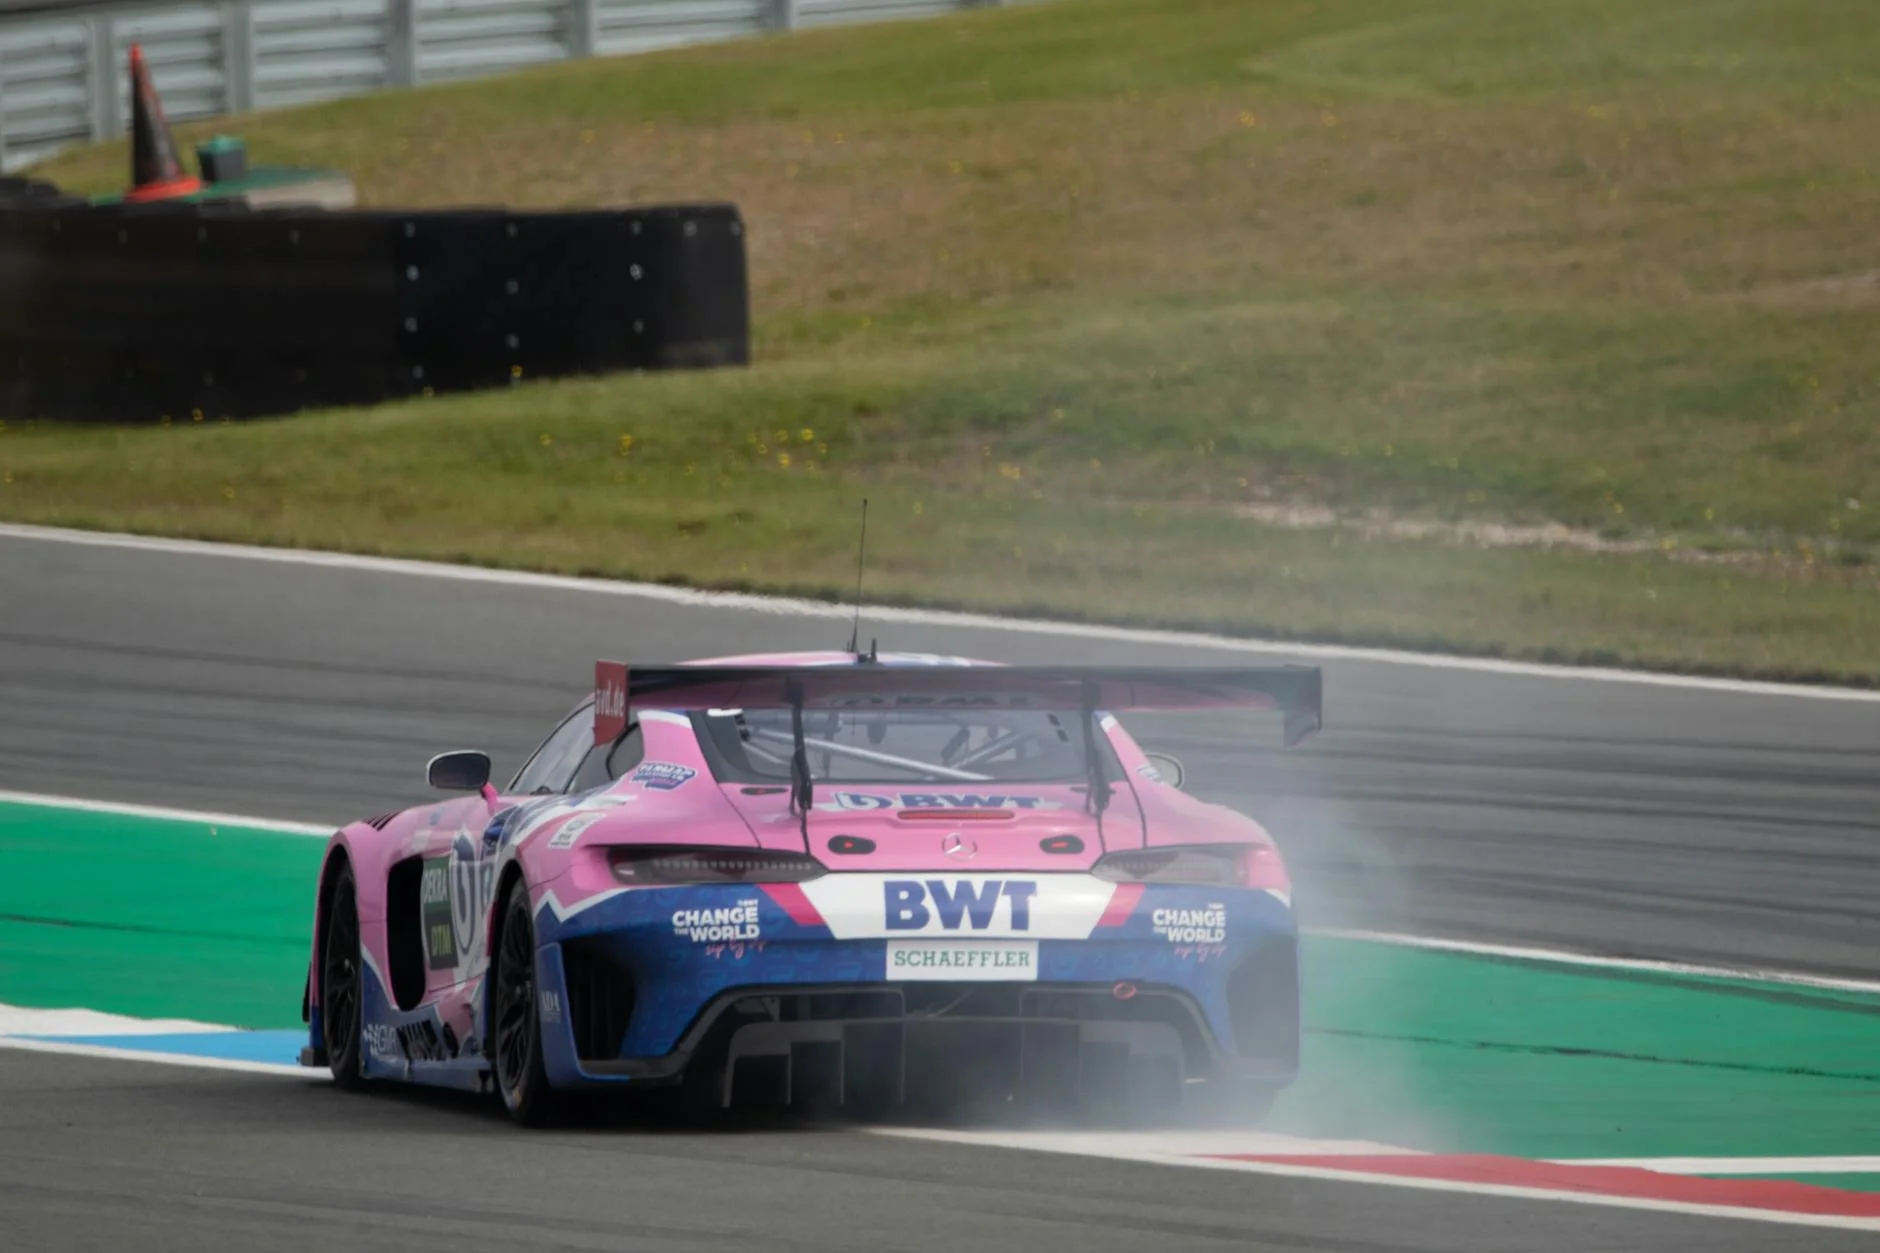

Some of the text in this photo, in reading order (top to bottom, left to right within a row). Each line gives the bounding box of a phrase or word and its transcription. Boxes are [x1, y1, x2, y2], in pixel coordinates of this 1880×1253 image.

[898, 794, 1041, 808] BWT
[884, 880, 1037, 931] BWT
[672, 906, 759, 927] CHANGE
[1153, 909, 1226, 927] CHANGE
[690, 924, 760, 942] WORLD
[1167, 927, 1225, 942] WORLD
[894, 951, 1030, 967] SCHAEFFLER
